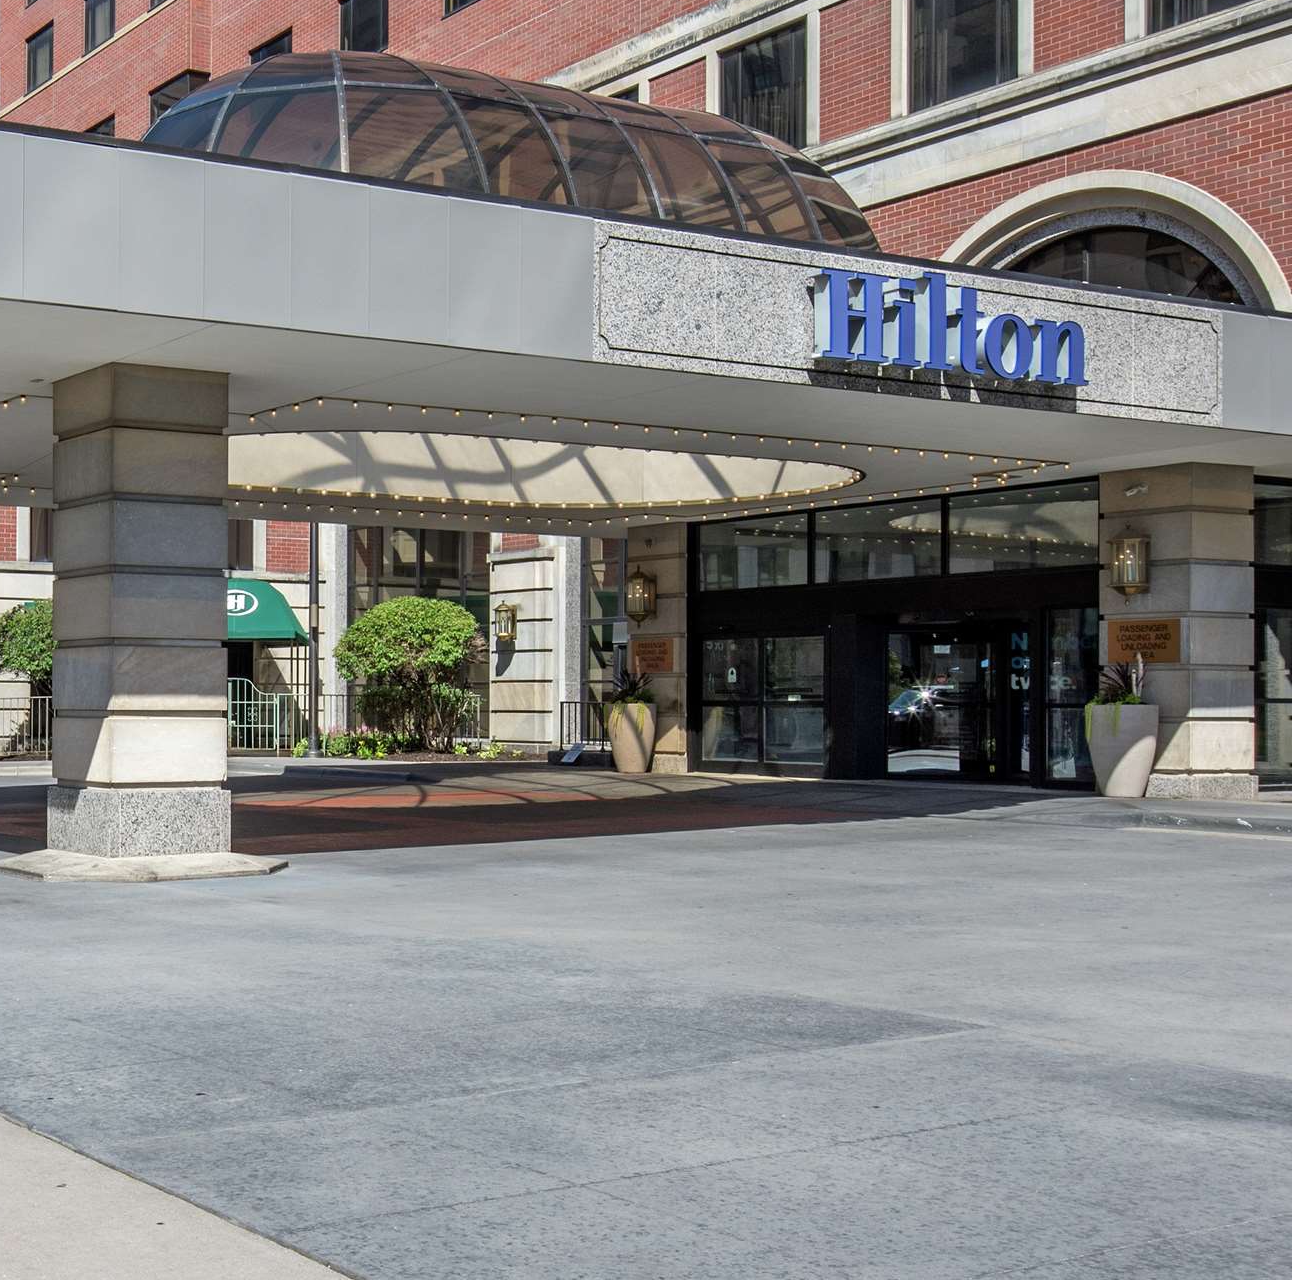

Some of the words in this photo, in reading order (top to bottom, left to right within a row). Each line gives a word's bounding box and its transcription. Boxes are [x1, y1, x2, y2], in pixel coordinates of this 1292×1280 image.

[822, 268, 1089, 386] Hilton
[1119, 624, 1168, 633] PASSENGER
[1116, 633, 1151, 642] LOADING
[1154, 633, 1171, 641] AND
[1120, 642, 1167, 651] UNLOADING
